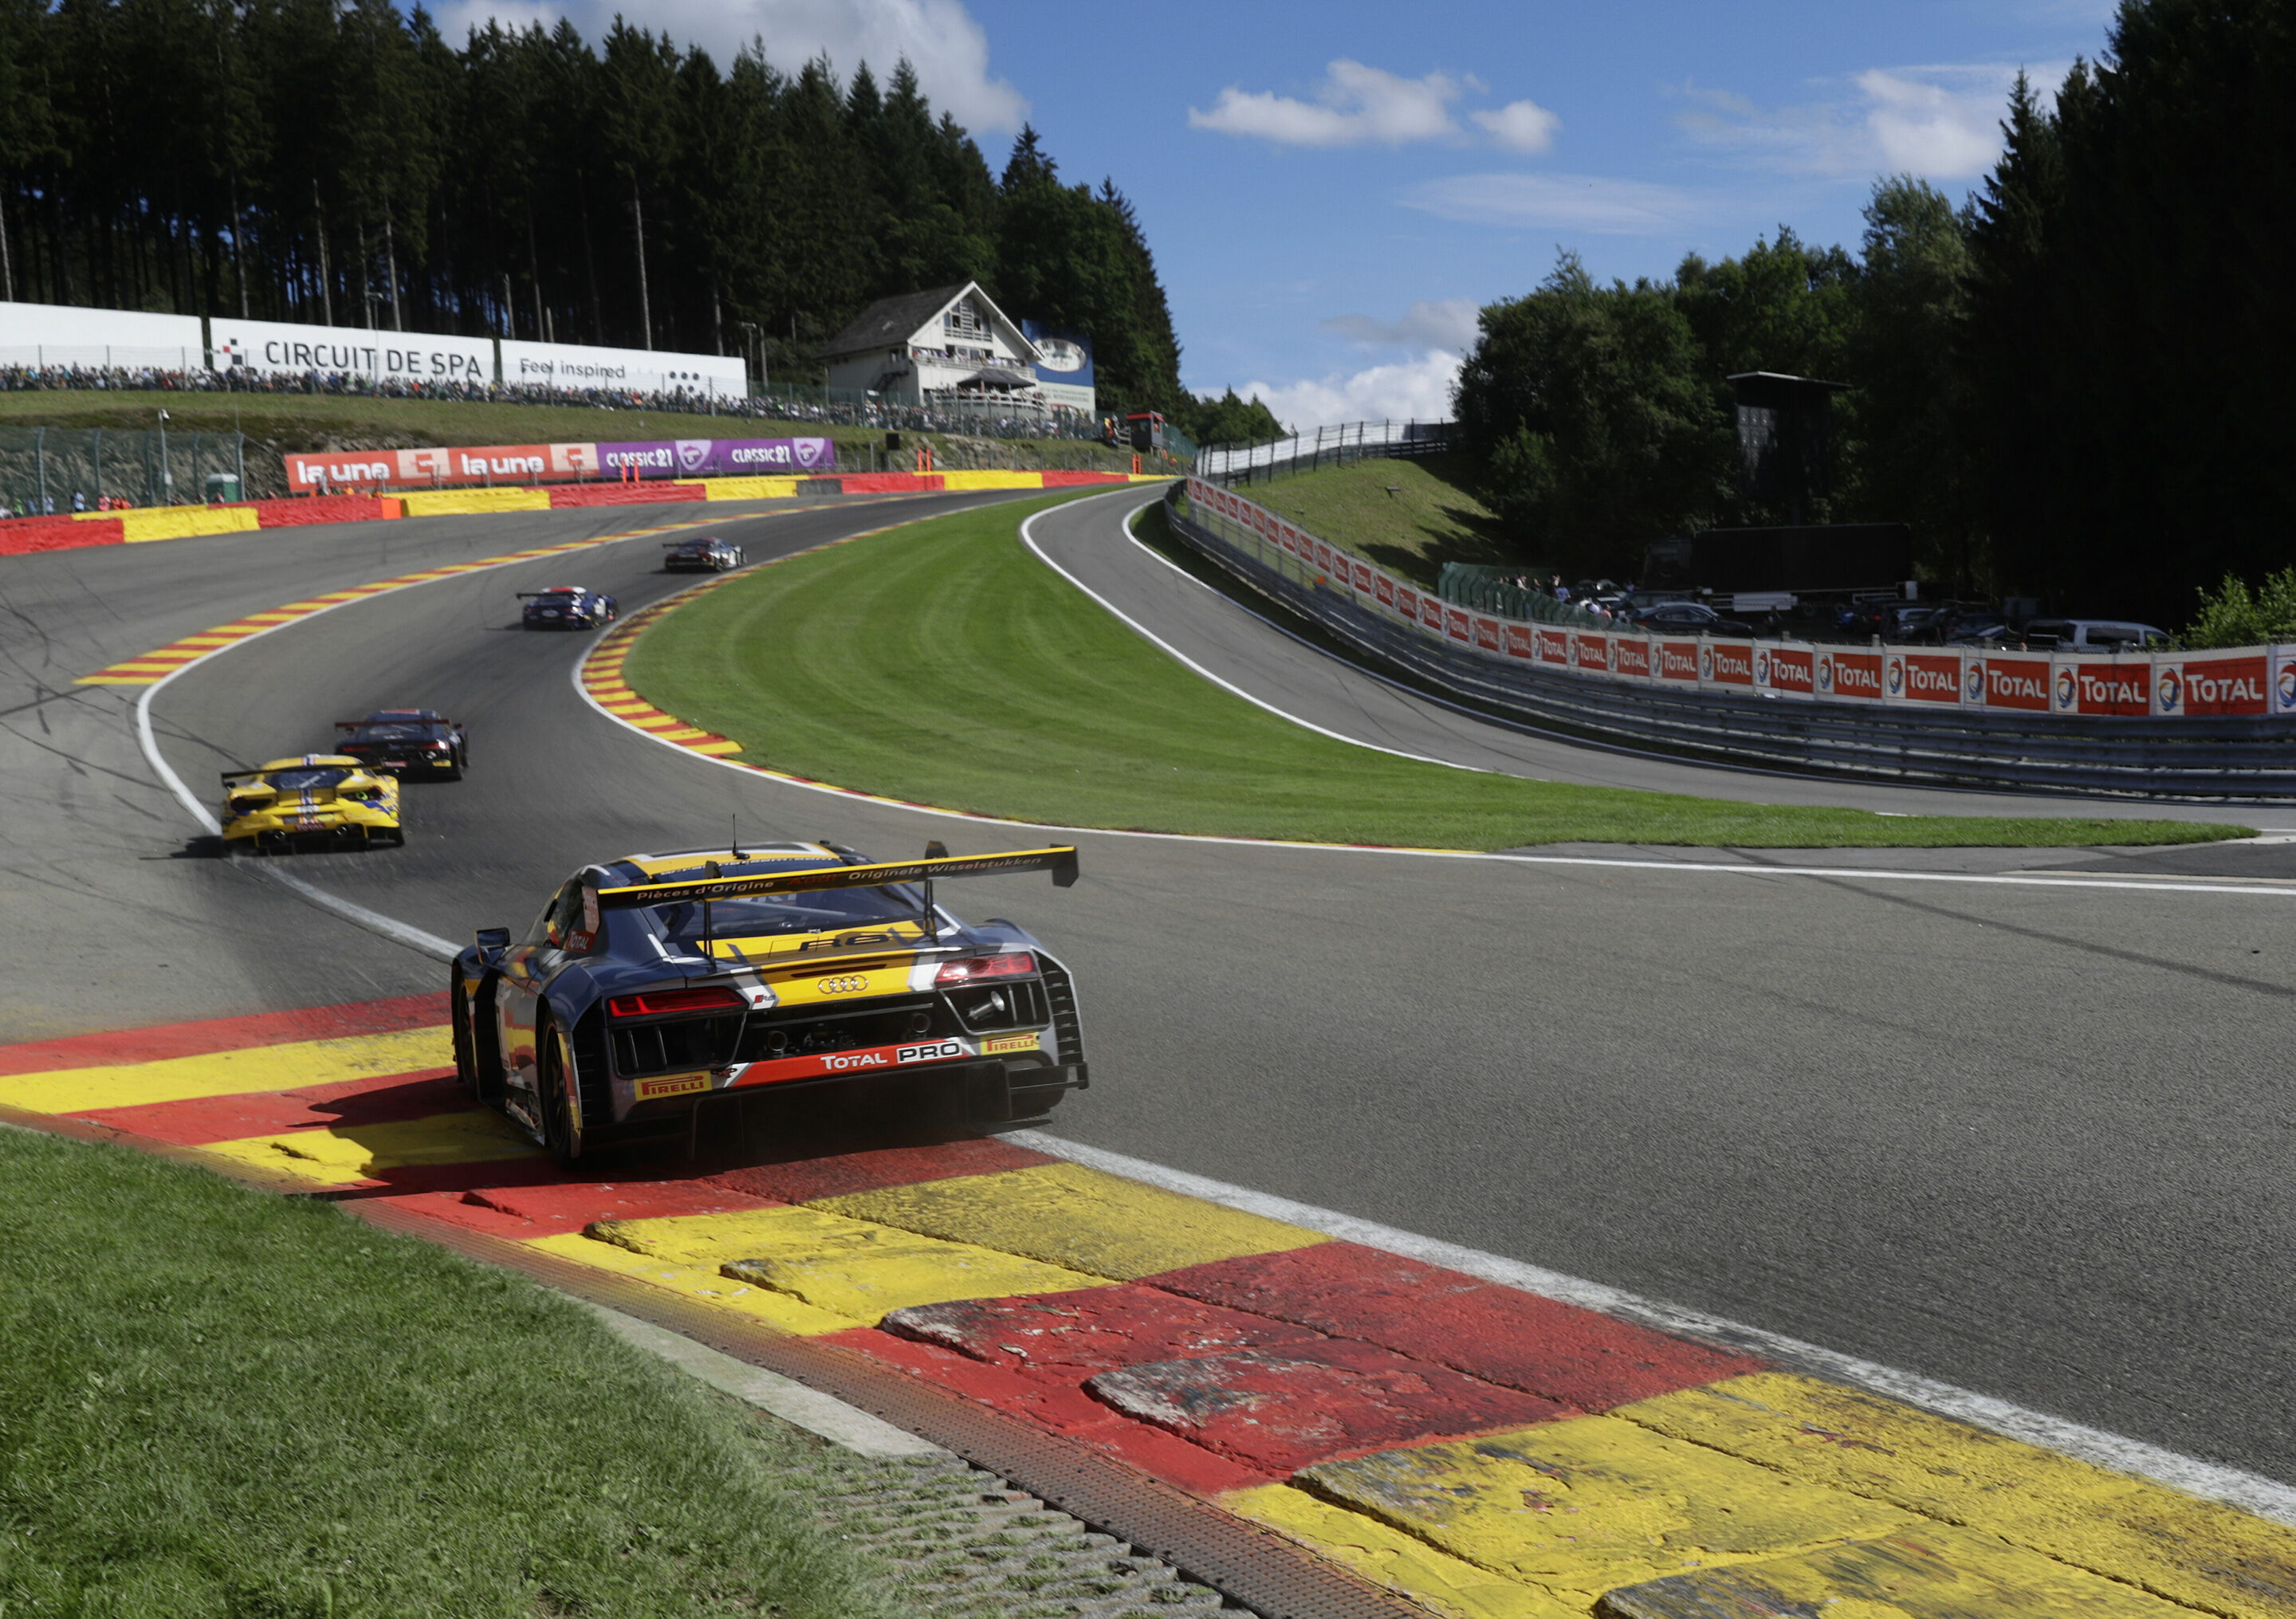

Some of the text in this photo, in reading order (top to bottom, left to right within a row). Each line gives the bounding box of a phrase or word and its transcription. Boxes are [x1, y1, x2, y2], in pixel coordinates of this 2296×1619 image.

[265, 341, 482, 378] CIRCUIT DE SPA
[520, 359, 625, 379] Feel inspired
[330, 462, 391, 482] une
[461, 454, 545, 476] la une
[1507, 631, 1531, 652] TOTAL
[1542, 637, 1566, 658] TOTAL
[1578, 642, 1606, 663] TOTAL
[1618, 647, 1649, 668] TOTAL
[1663, 650, 1697, 672] TOTAL
[1716, 653, 1751, 676] TOTAL
[1771, 658, 1812, 683] TOTAL
[1835, 662, 1881, 688] TOTAL
[1907, 665, 1958, 691] TOTAL
[1988, 669, 2047, 698] TOTAL
[2080, 675, 2148, 703] TOTAL
[2185, 674, 2264, 702] TOTAL
[636, 888, 690, 901] Pièces
[694, 880, 774, 895] d'Origine
[848, 866, 923, 881] Originele
[926, 856, 1042, 874] Wisselstukken
[568, 930, 590, 951] TOTAL
[820, 1043, 961, 1071] TOTAL PRO
[641, 1075, 705, 1096] PIRELLI
